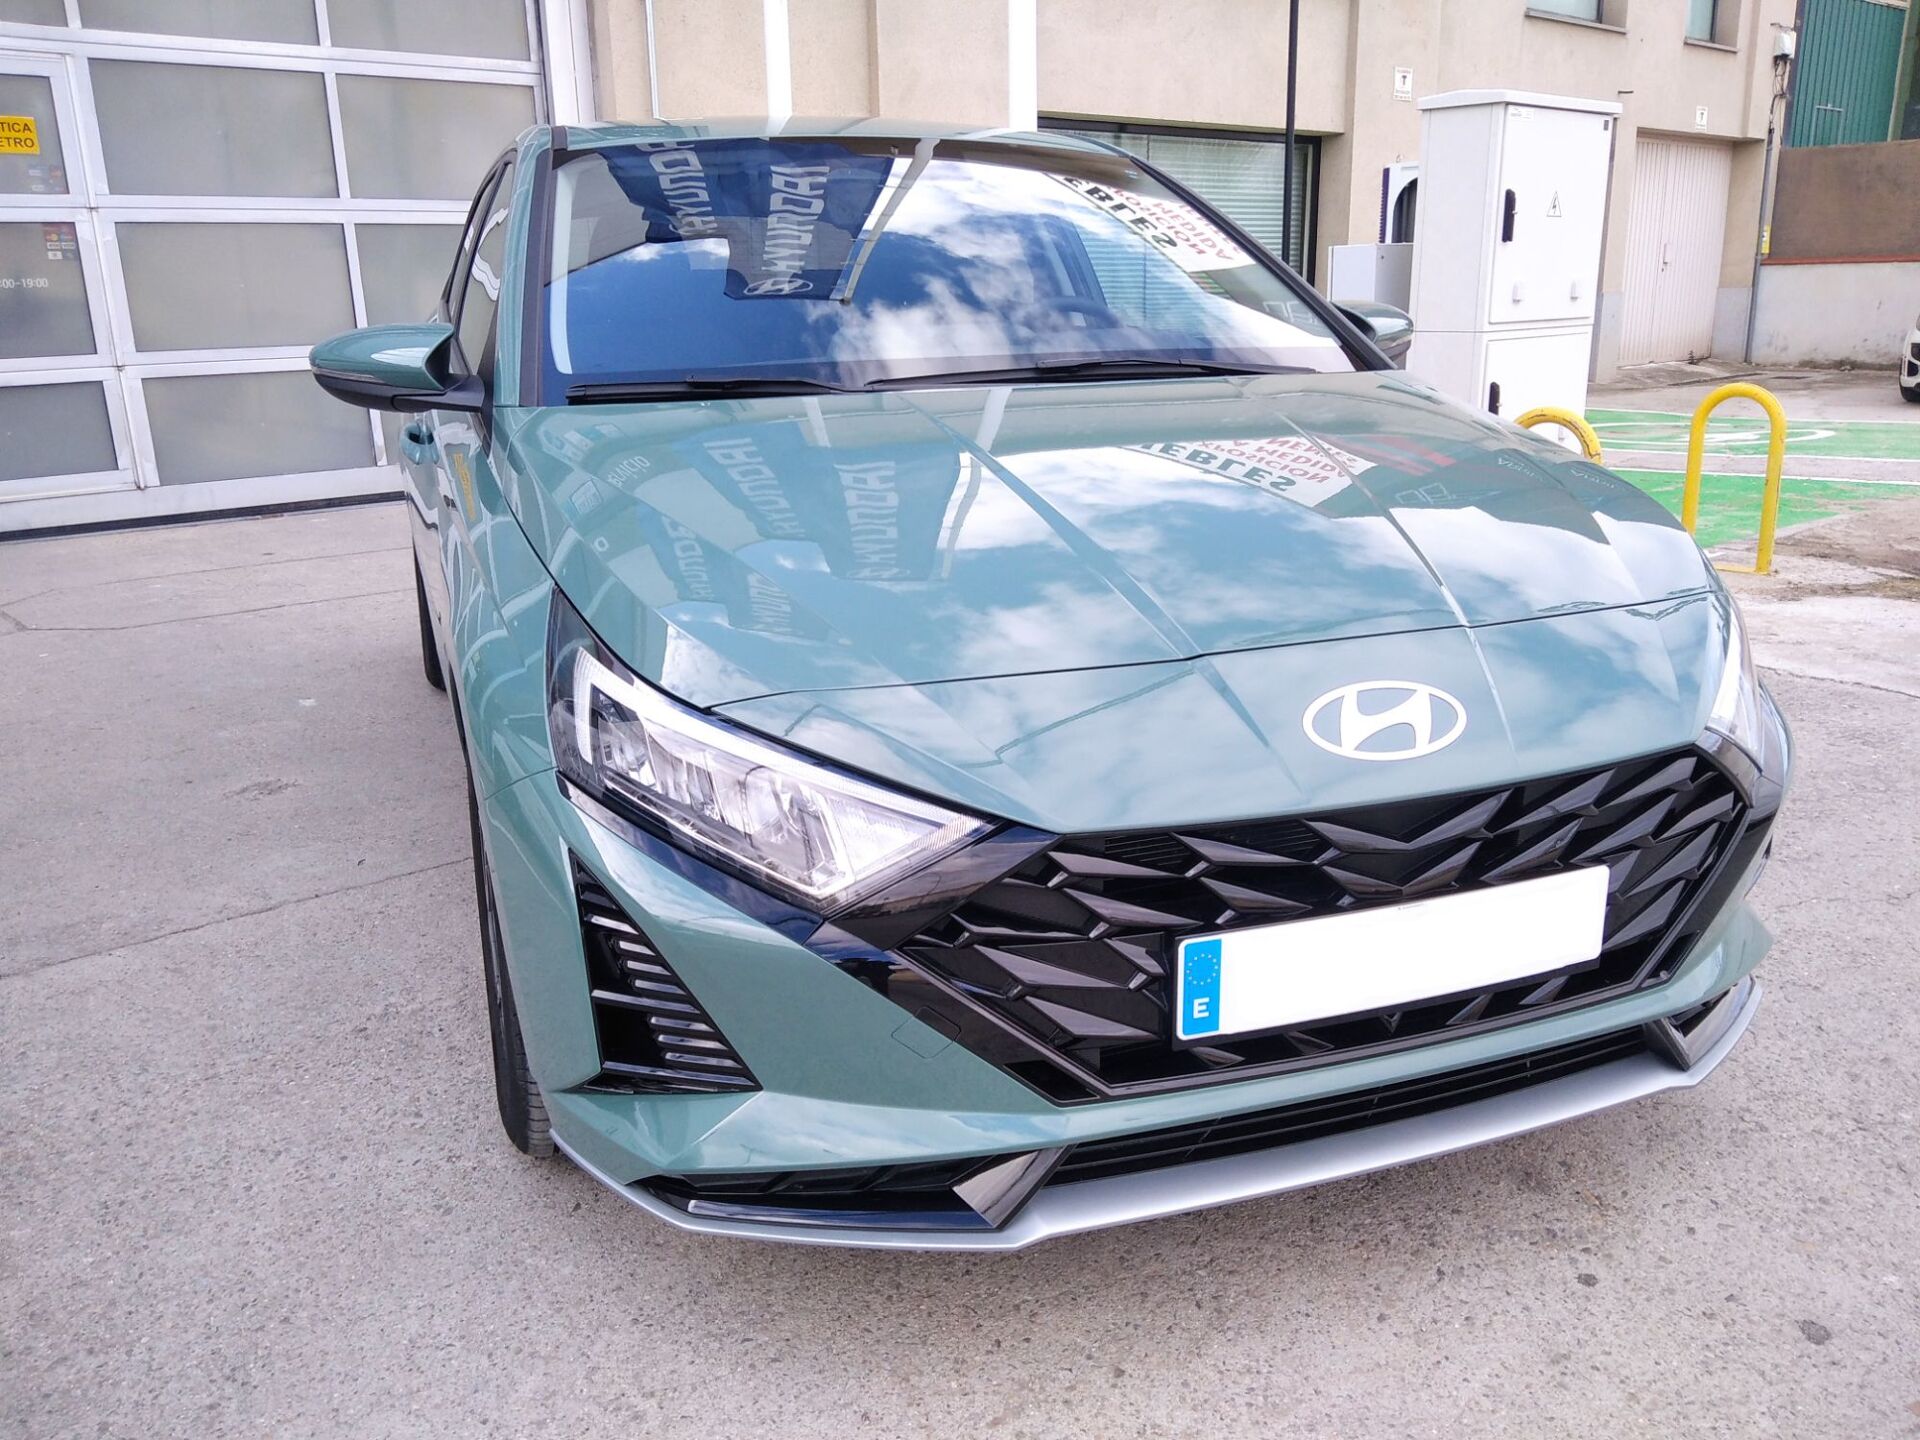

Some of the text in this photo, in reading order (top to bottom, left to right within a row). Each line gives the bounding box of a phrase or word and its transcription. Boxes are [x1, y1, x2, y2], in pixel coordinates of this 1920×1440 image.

[761, 165, 830, 274] HYUNDAI
[703, 438, 806, 537] HYUNDAI
[833, 461, 899, 564] HYUNDAI
[1193, 997, 1210, 1019] E
